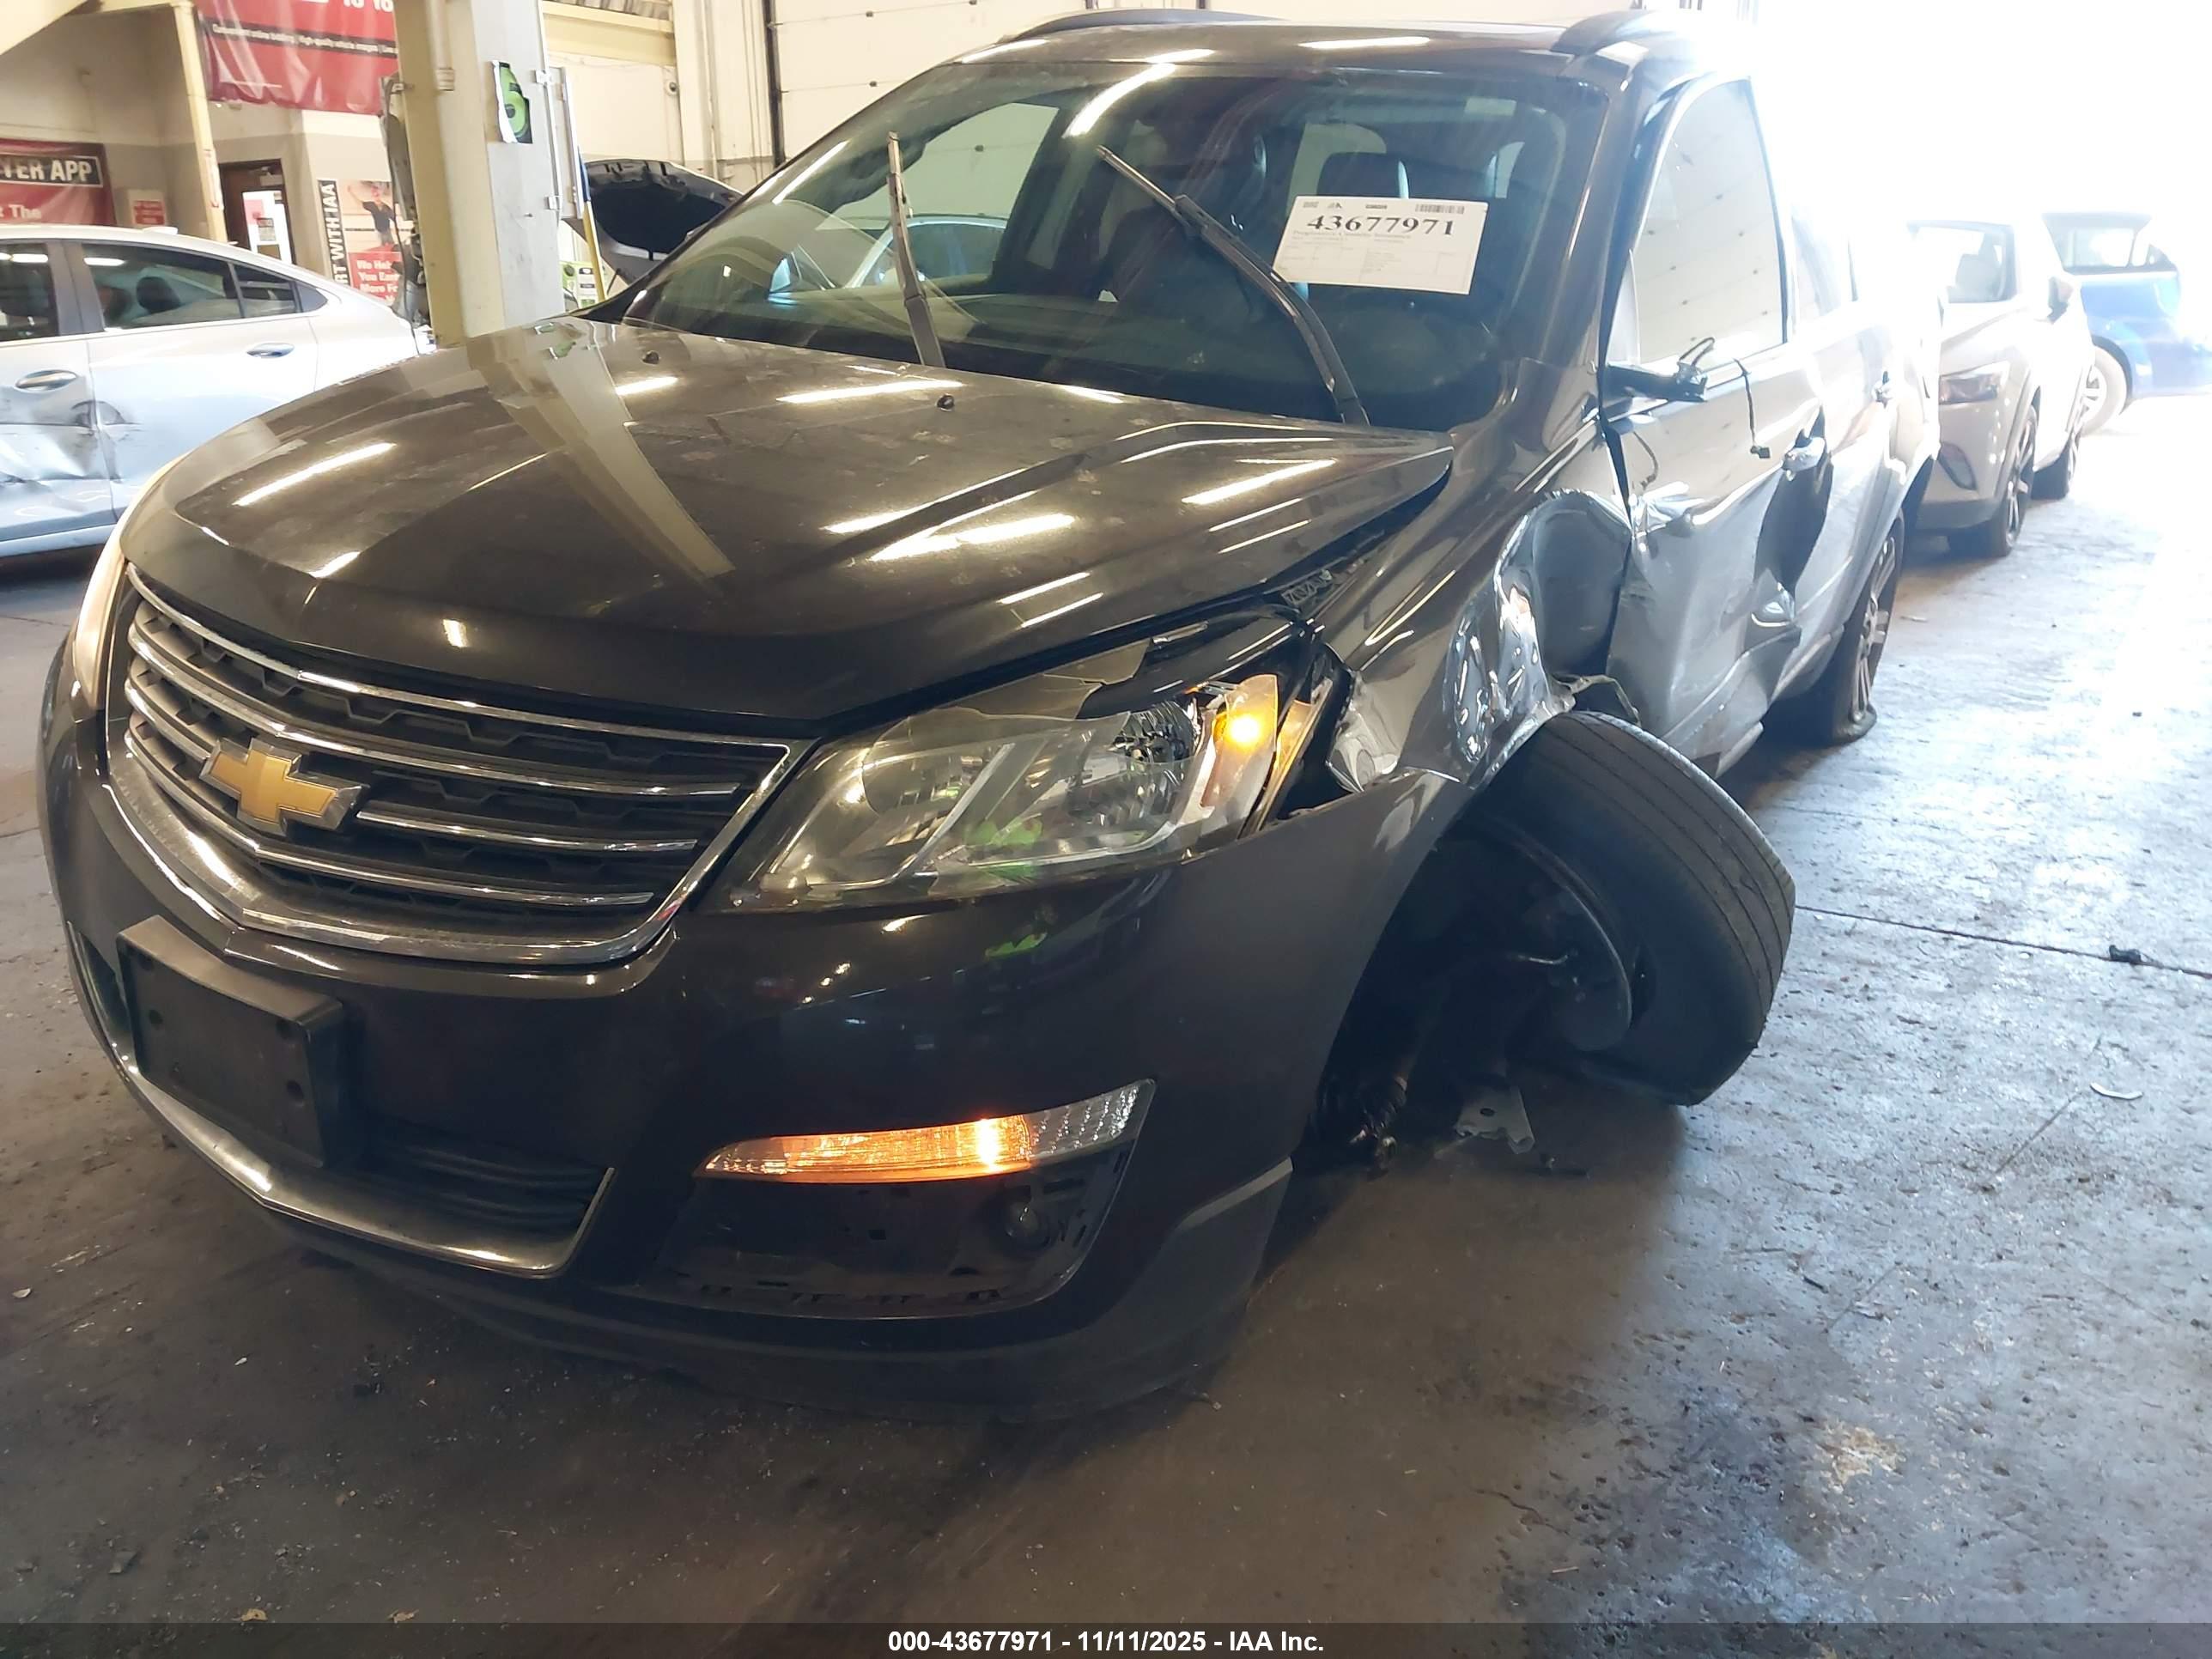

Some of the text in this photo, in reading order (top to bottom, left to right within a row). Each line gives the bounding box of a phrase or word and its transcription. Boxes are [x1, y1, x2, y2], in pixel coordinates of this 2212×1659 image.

[50, 159, 93, 182] APP
[320, 183, 338, 213] IAA
[1307, 214, 1453, 235] 43677971
[325, 217, 344, 259] WITH
